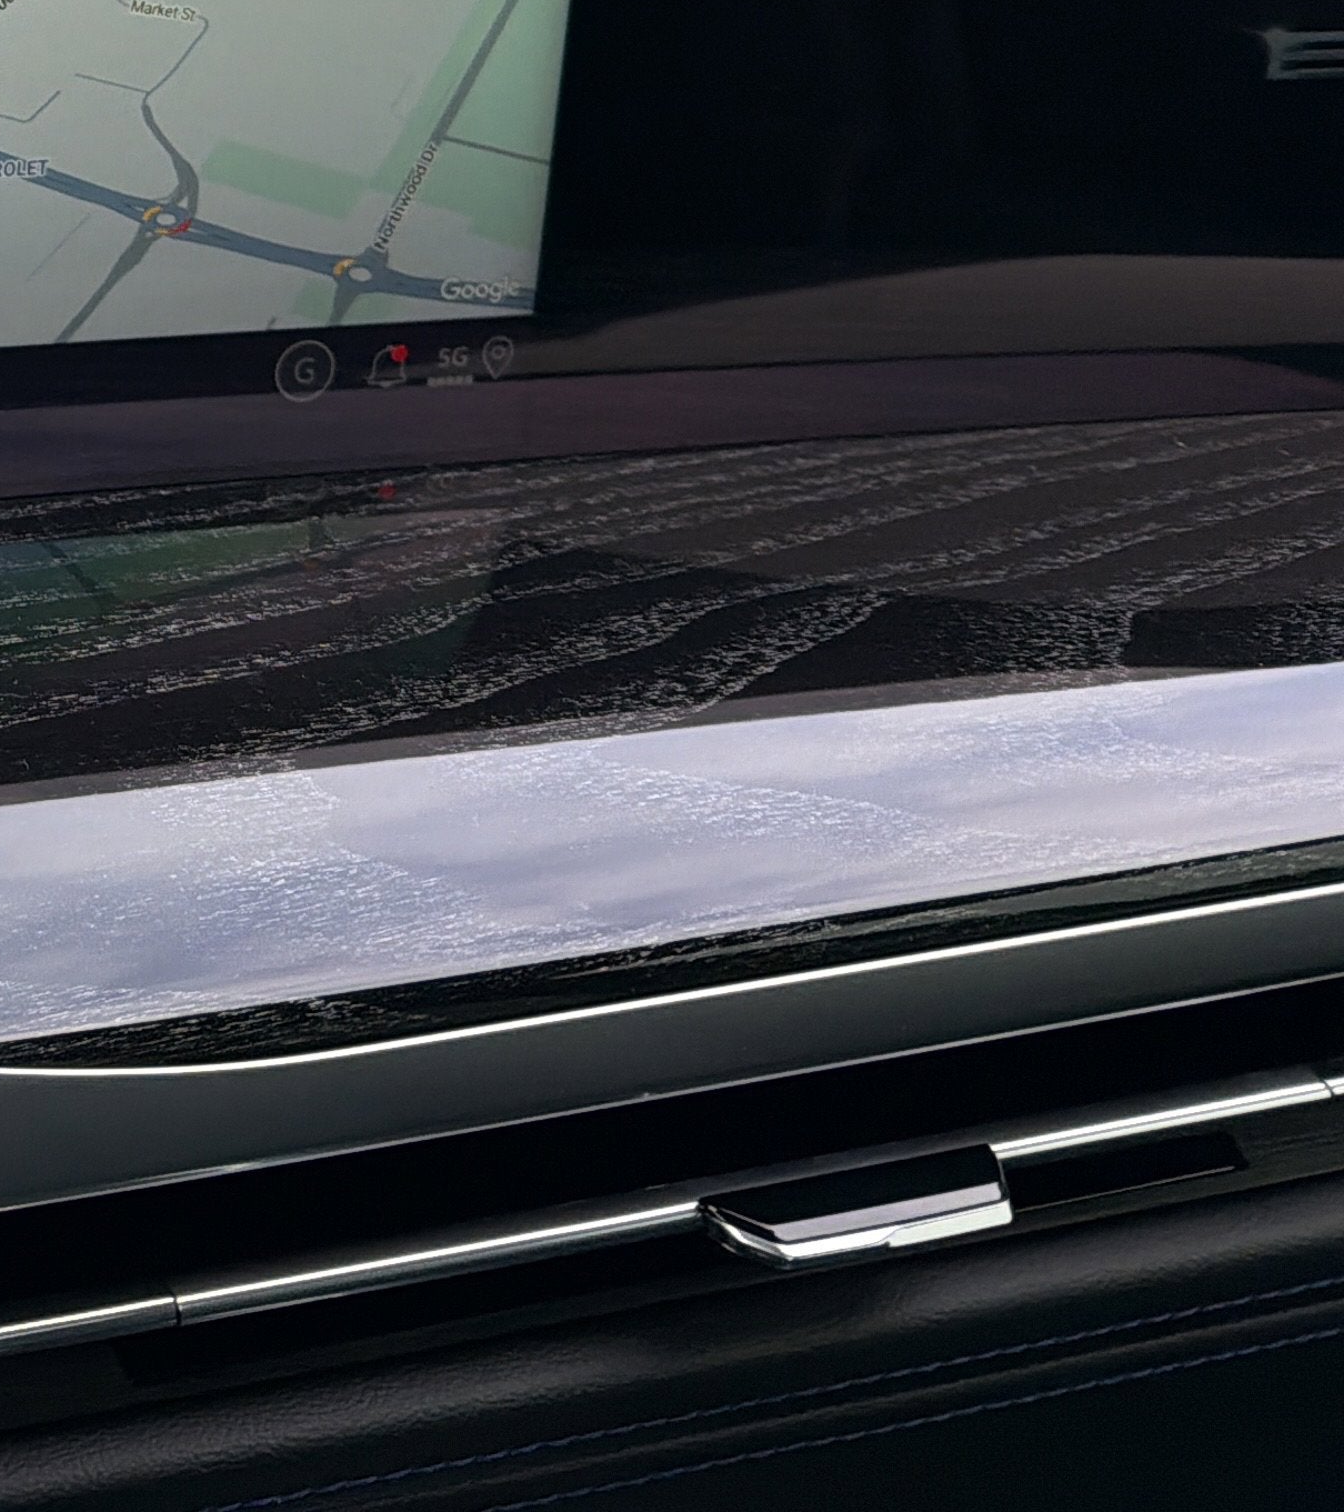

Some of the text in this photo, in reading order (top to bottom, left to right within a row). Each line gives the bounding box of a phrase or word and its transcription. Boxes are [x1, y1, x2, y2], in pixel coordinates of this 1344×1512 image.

[130, 0, 197, 22] Market St
[373, 144, 438, 250] Northwood Dr
[440, 277, 520, 302] Google
[438, 346, 469, 368] 5G
